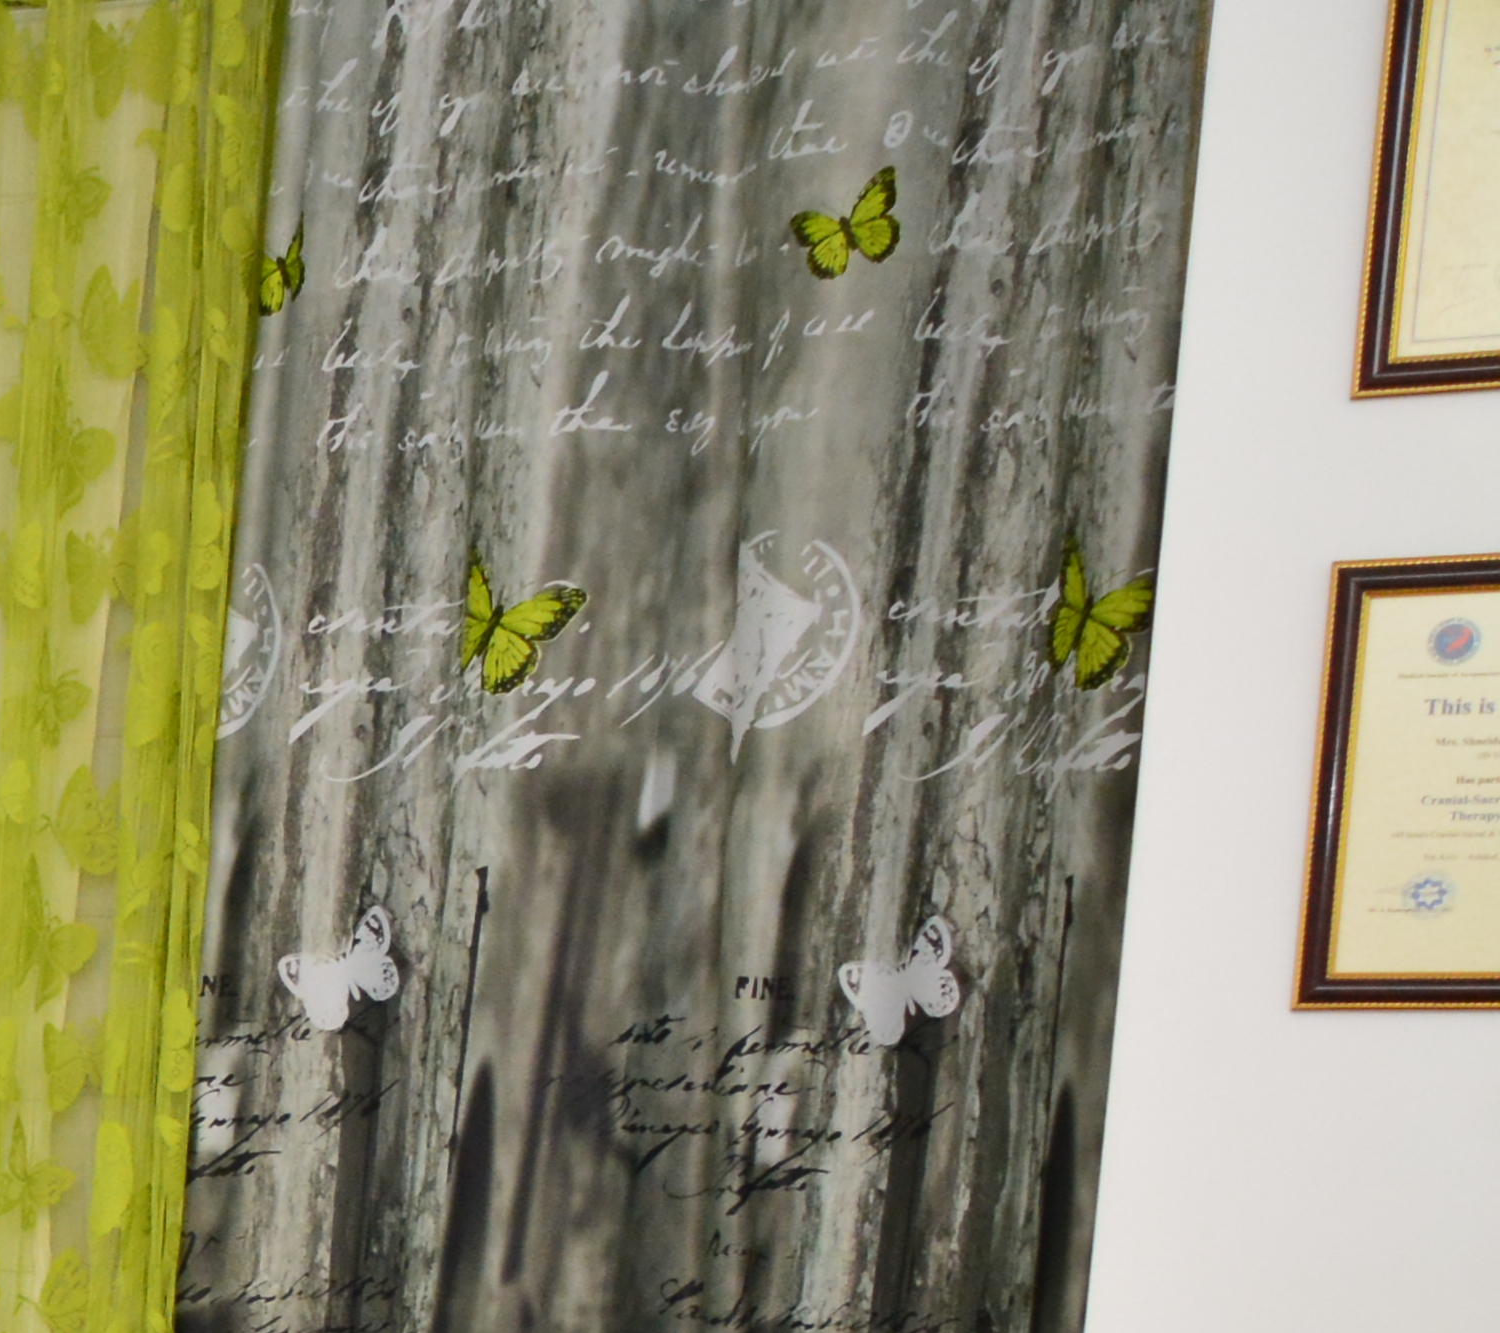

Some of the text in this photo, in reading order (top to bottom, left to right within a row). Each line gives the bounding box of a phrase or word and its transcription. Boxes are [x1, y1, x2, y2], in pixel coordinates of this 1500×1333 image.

[1424, 696, 1496, 716] This is
[1456, 775, 1476, 785] Has
